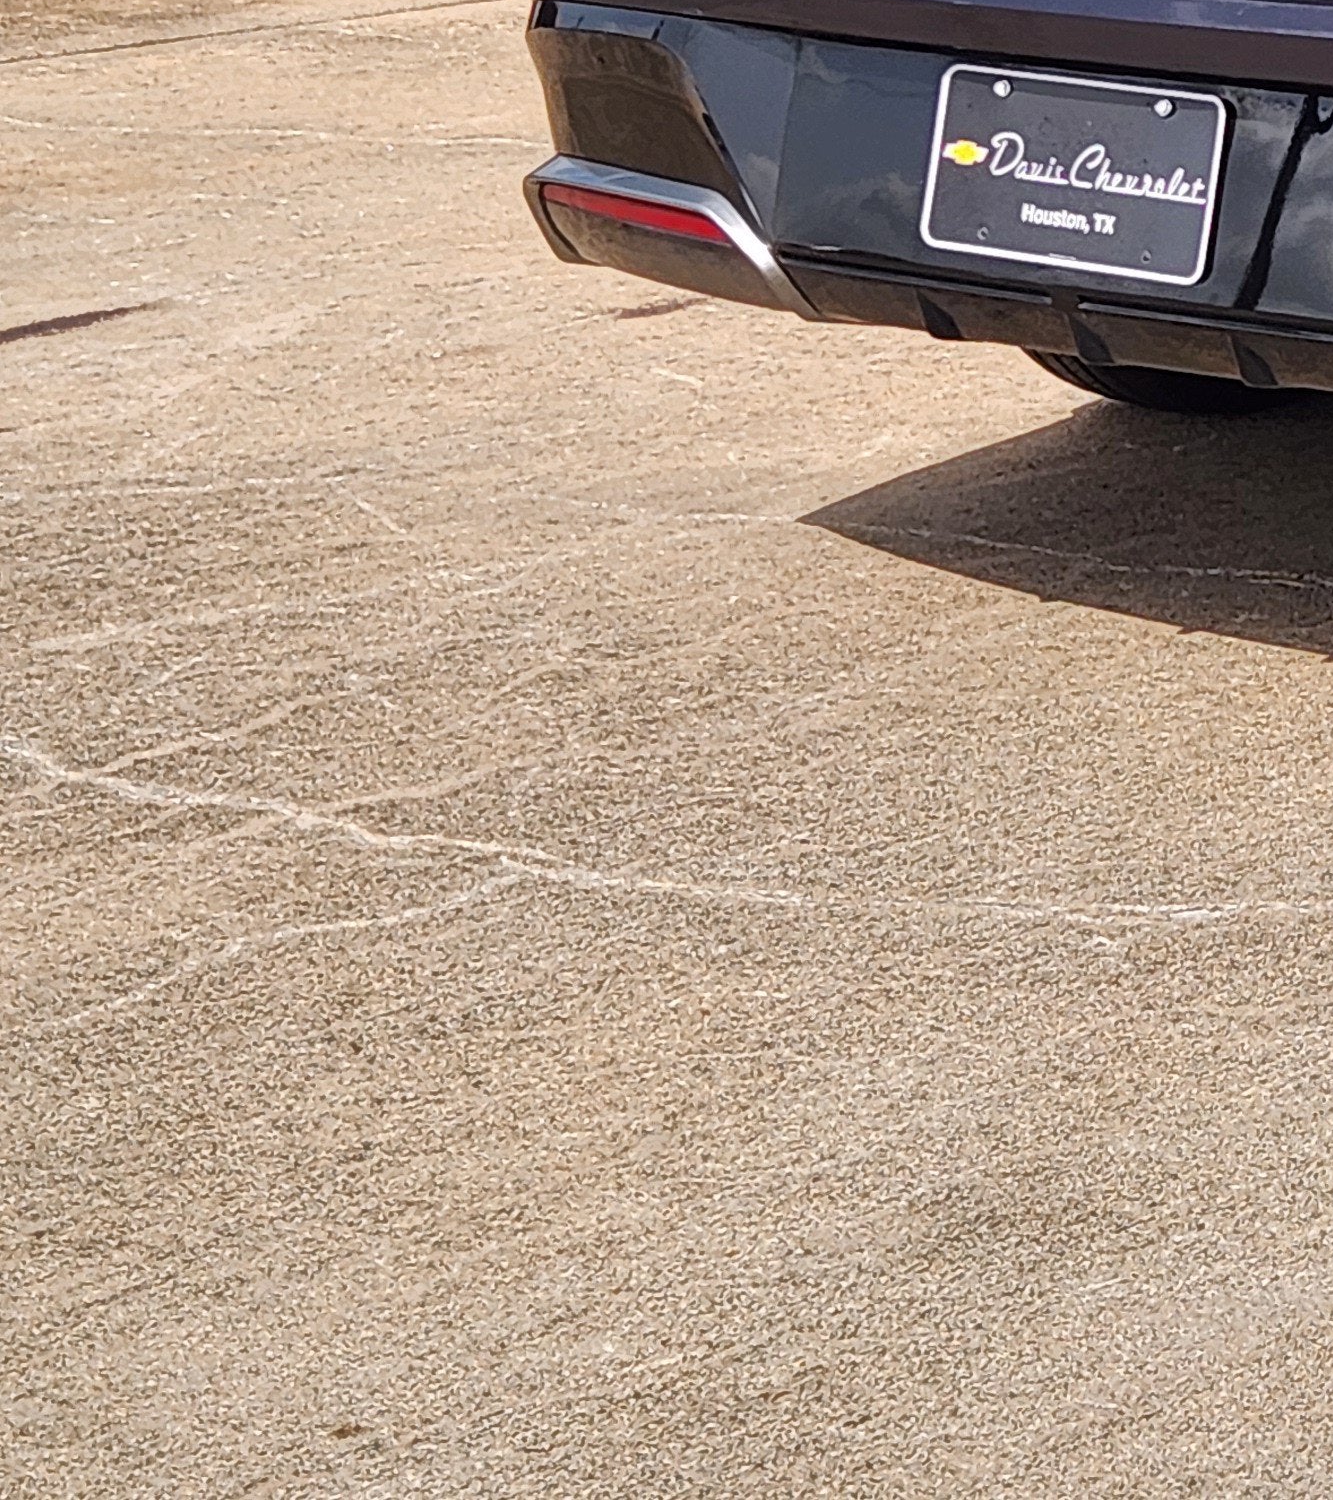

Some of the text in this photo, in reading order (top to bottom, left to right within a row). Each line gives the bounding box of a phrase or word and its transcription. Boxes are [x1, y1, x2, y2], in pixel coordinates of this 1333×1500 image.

[988, 131, 1206, 205] Davis Chevrolet
[1020, 202, 1116, 235] Houston, TX
